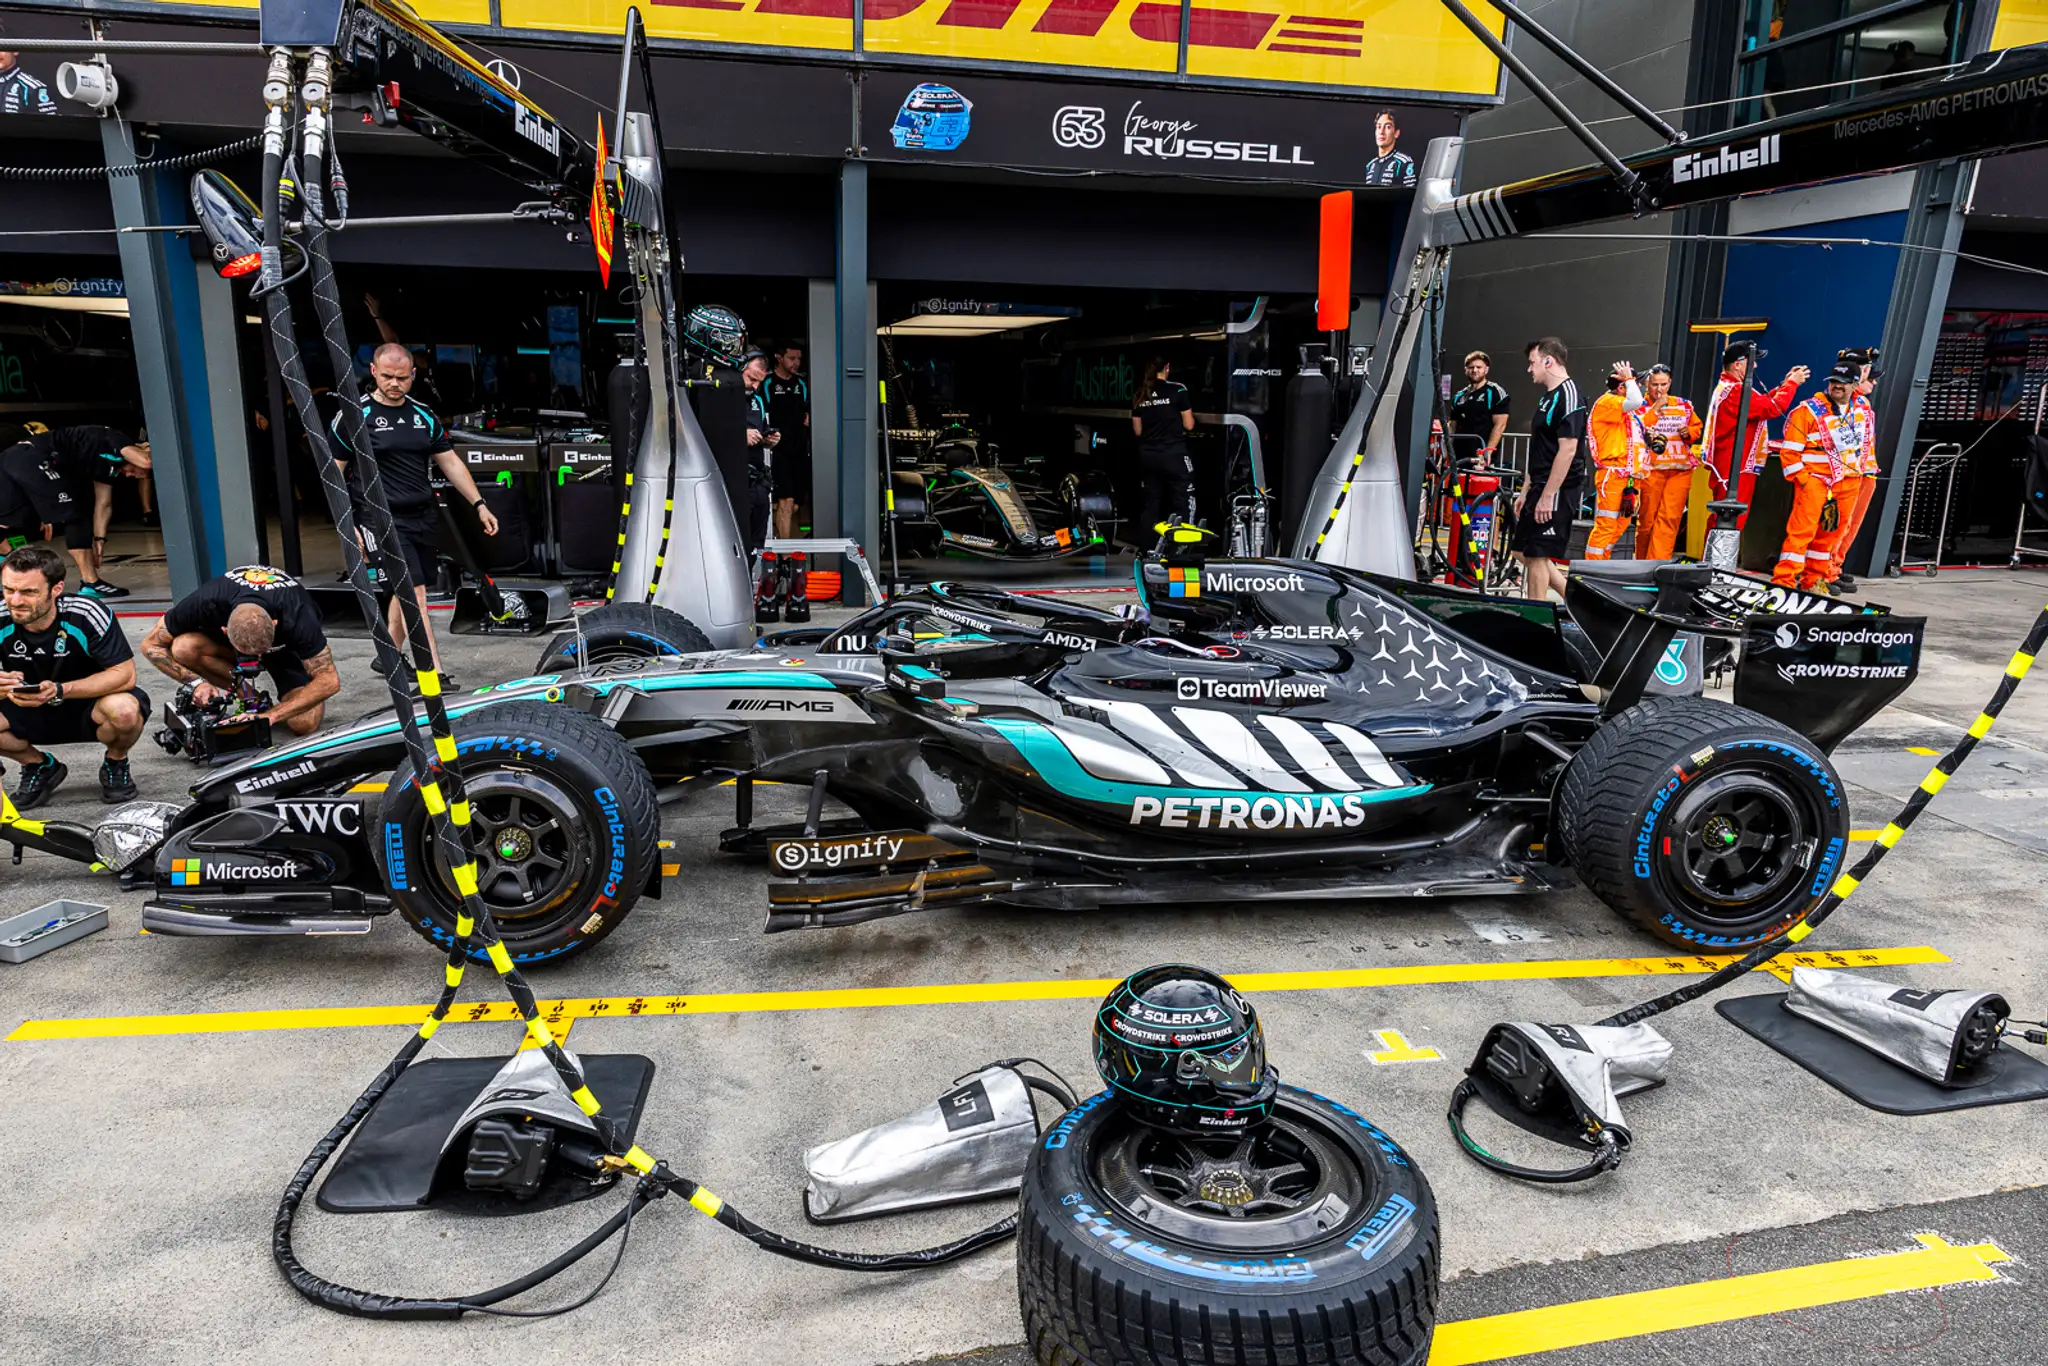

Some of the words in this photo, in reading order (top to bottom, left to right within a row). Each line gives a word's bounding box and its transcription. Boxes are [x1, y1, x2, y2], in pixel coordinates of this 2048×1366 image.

[1834, 96, 1949, 140] Mercedes-AMG
[1952, 73, 2048, 115] PETRONAS
[514, 100, 560, 157] Einhell
[1053, 105, 1105, 149] 63
[1124, 100, 1198, 152] George
[1124, 135, 1315, 165] RUSSELL
[1673, 134, 1781, 184] Einhell
[1073, 354, 1135, 401] Australia
[1206, 573, 1305, 592] Microsoft
[933, 604, 992, 633] CROWDSTRIKE
[1269, 625, 1350, 640] SOLERA
[1042, 631, 1082, 649] AMD
[1807, 626, 1914, 647] Snapdragon
[1786, 664, 1909, 679] CROWDSTRIKE
[1202, 680, 1328, 698] TeamViewer
[761, 701, 835, 713] AMG
[235, 760, 318, 795] Einhell
[275, 803, 361, 836] IWC
[1130, 795, 1366, 829] PETRONAS
[1633, 775, 1681, 879] Cinturato
[385, 822, 409, 890] PIRELLI
[593, 787, 626, 898] Cinturato
[774, 835, 904, 871] Signify
[206, 860, 299, 881] Microsoft
[1810, 836, 1845, 898] PIRELLI
[1113, 1018, 1168, 1042] CROWDSTRIKE
[1144, 1009, 1205, 1025] SOLERA
[1174, 1026, 1233, 1042] CROWDSTRIKE
[952, 1090, 978, 1117] LF1
[1199, 1116, 1249, 1126] Einhell
[1344, 1193, 1417, 1261] PIRELLI
